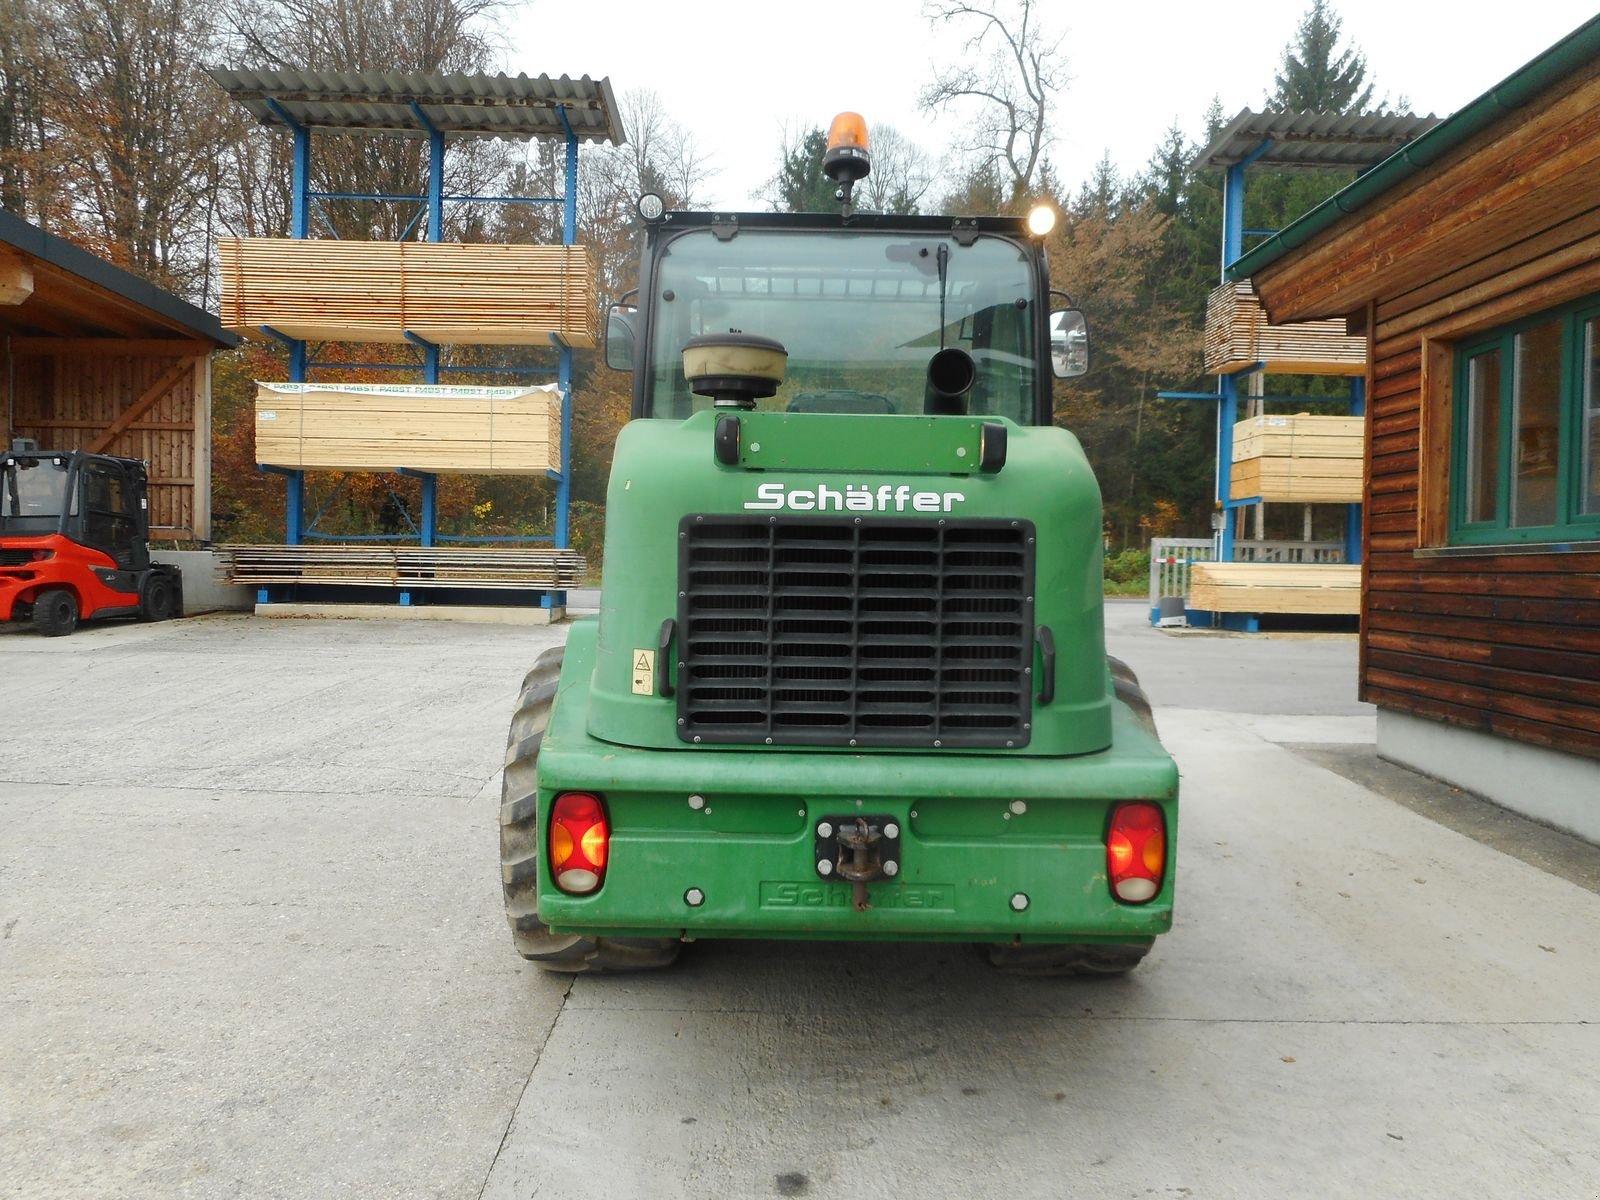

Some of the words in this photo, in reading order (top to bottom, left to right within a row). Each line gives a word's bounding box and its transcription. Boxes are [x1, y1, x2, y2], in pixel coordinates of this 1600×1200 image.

[344, 385, 375, 393] PABST
[379, 386, 410, 394] PABST
[414, 386, 446, 394] PABST
[451, 387, 483, 396] PABST
[743, 483, 966, 513] Schäffer
